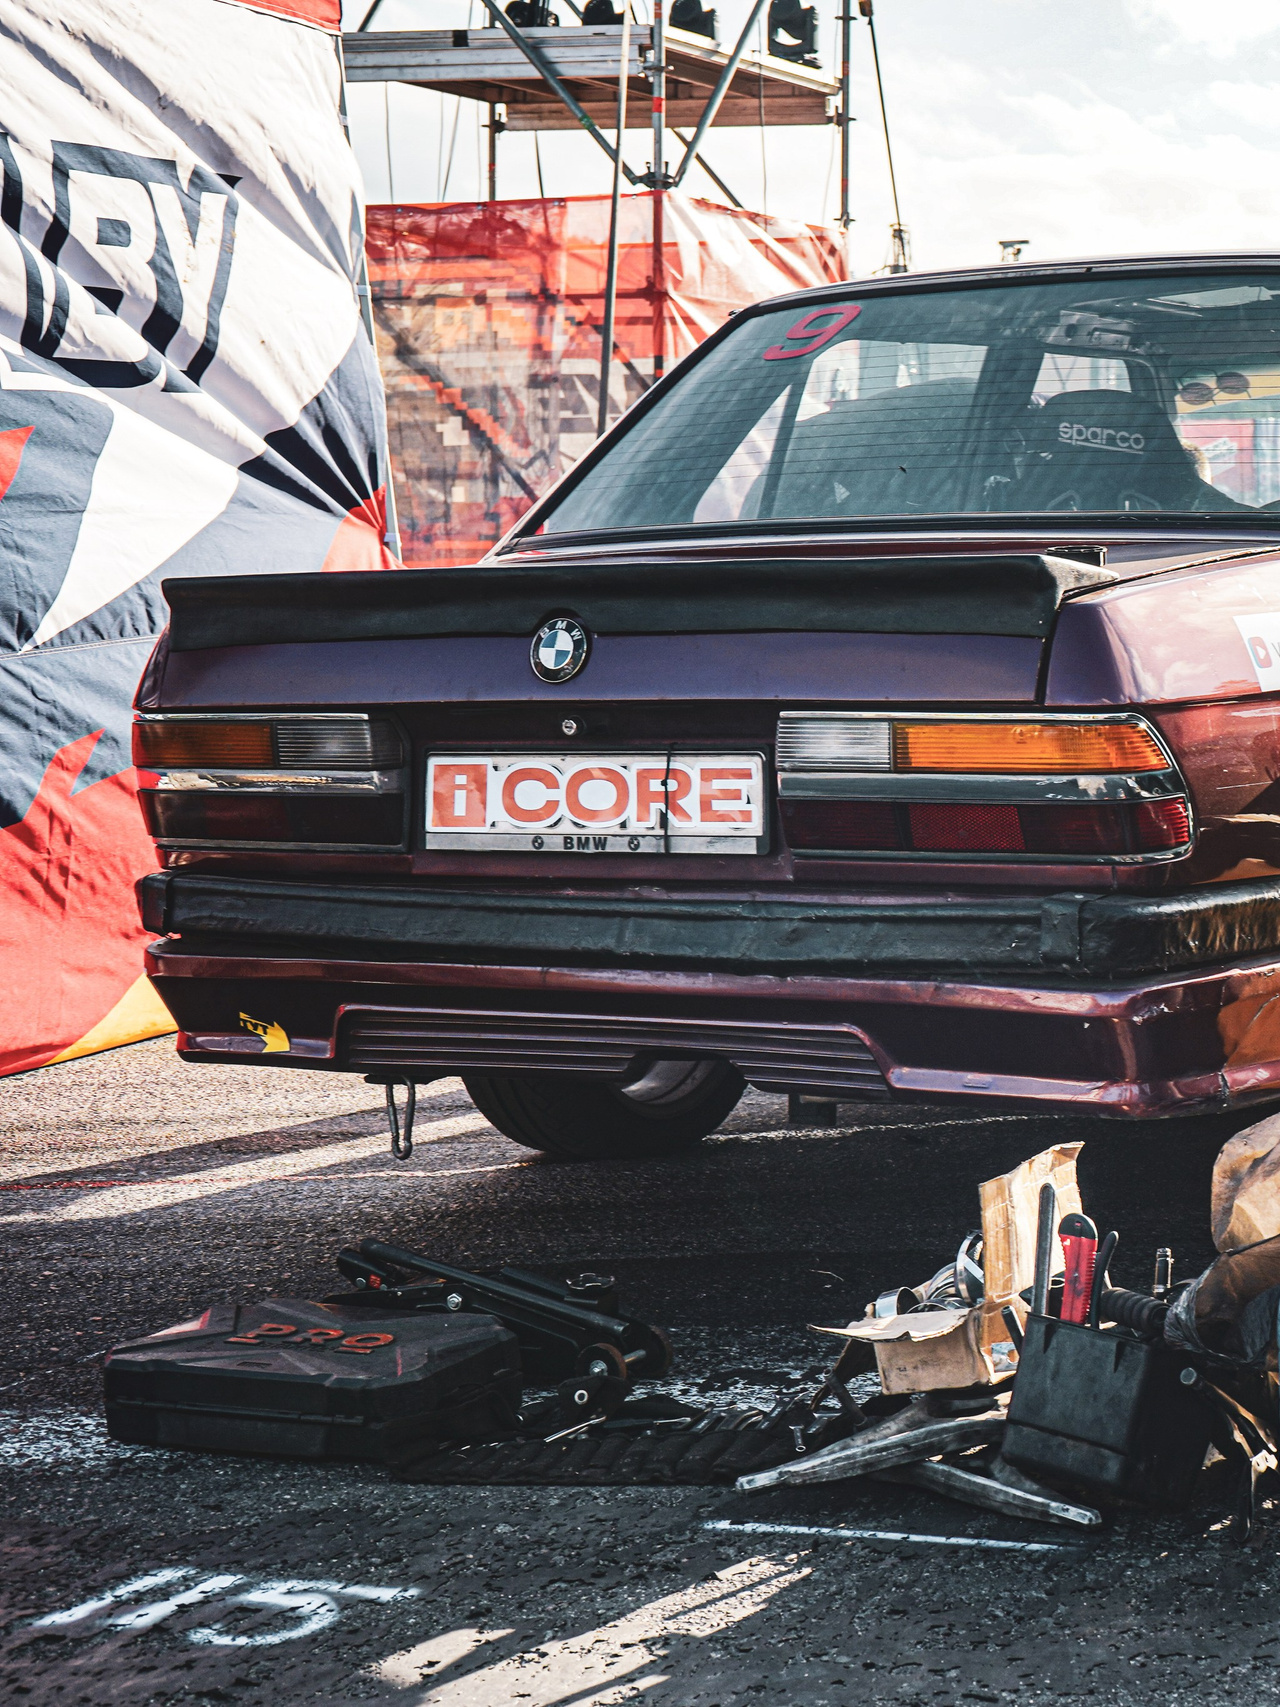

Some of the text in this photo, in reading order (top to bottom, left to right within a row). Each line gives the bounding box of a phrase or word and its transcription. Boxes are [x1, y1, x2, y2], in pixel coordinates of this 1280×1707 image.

[762, 305, 862, 361] 9
[1058, 422, 1145, 451] sparco
[540, 620, 582, 641] BMW
[563, 835, 608, 851] BMW
[224, 1323, 394, 1354] PRO
